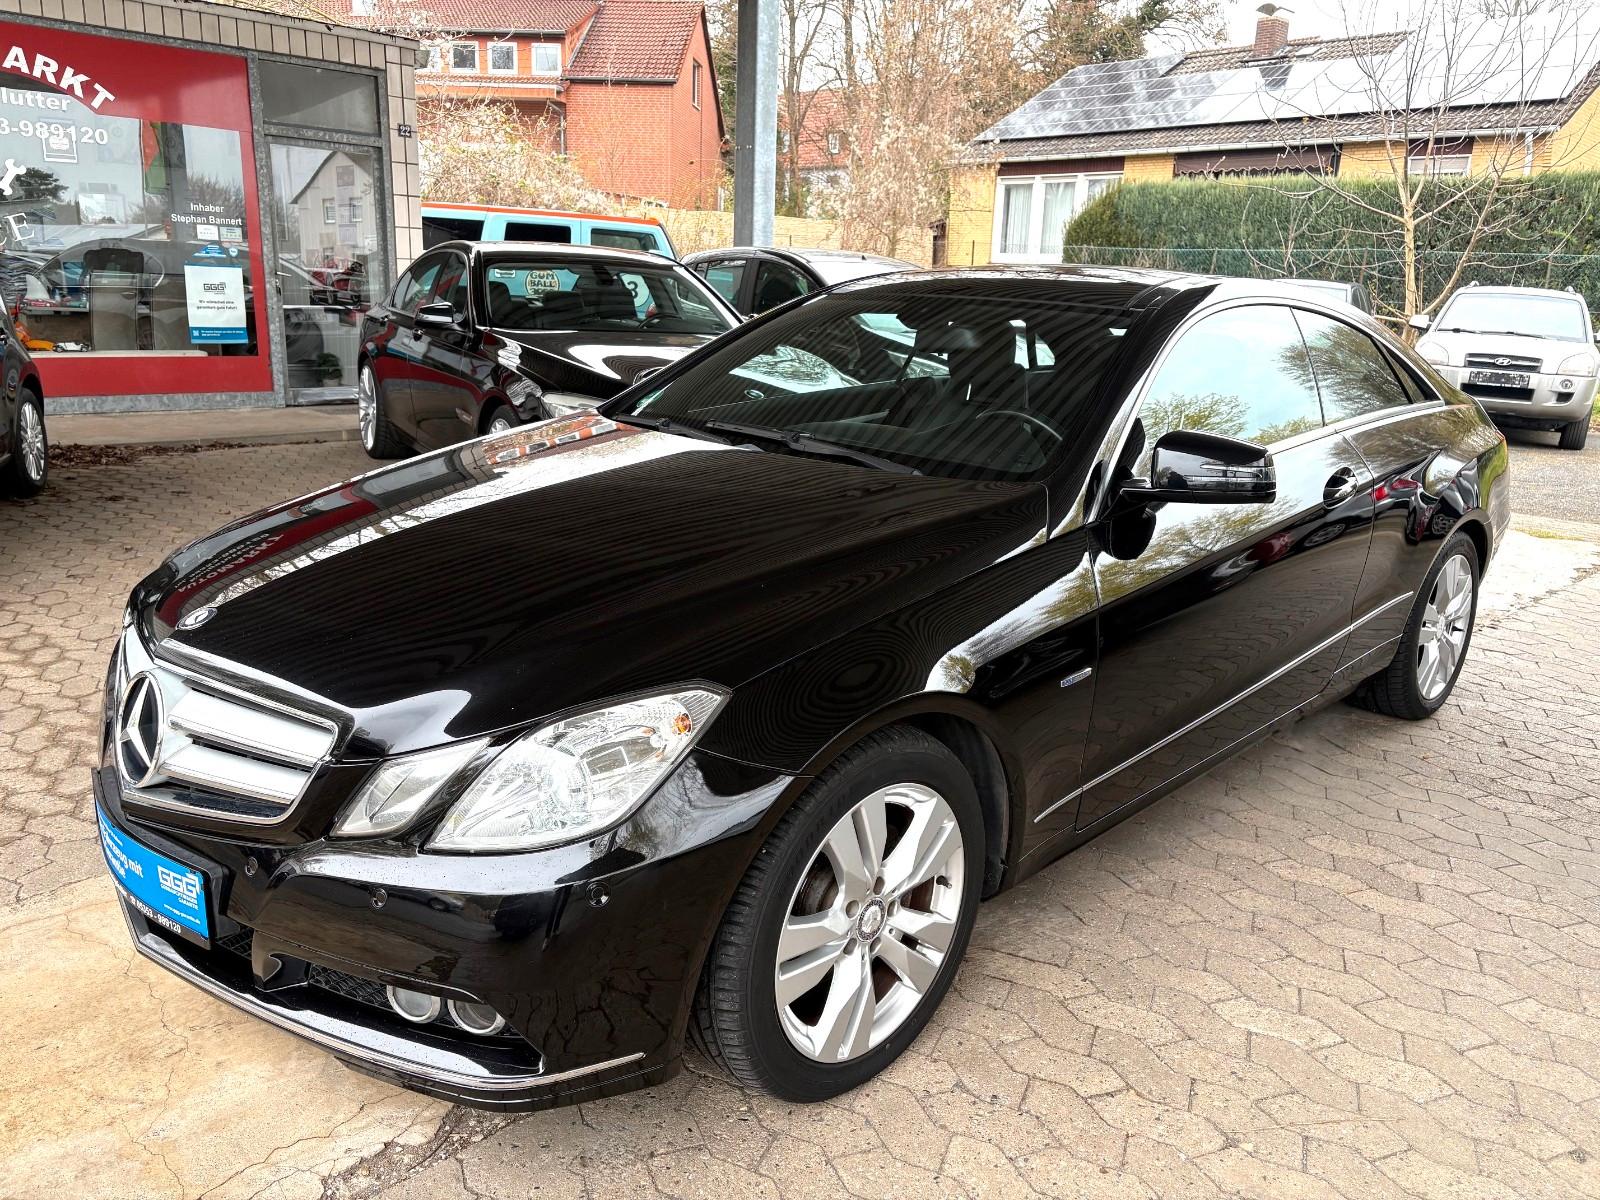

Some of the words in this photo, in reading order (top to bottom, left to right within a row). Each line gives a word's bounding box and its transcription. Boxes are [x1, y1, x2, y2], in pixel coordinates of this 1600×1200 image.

[2, 45, 116, 110] ARKT
[190, 202, 225, 213] Inhaber
[171, 213, 207, 225] Stephan
[208, 215, 243, 226] Bannert
[529, 270, 556, 280] GUM
[529, 279, 558, 288] BALL
